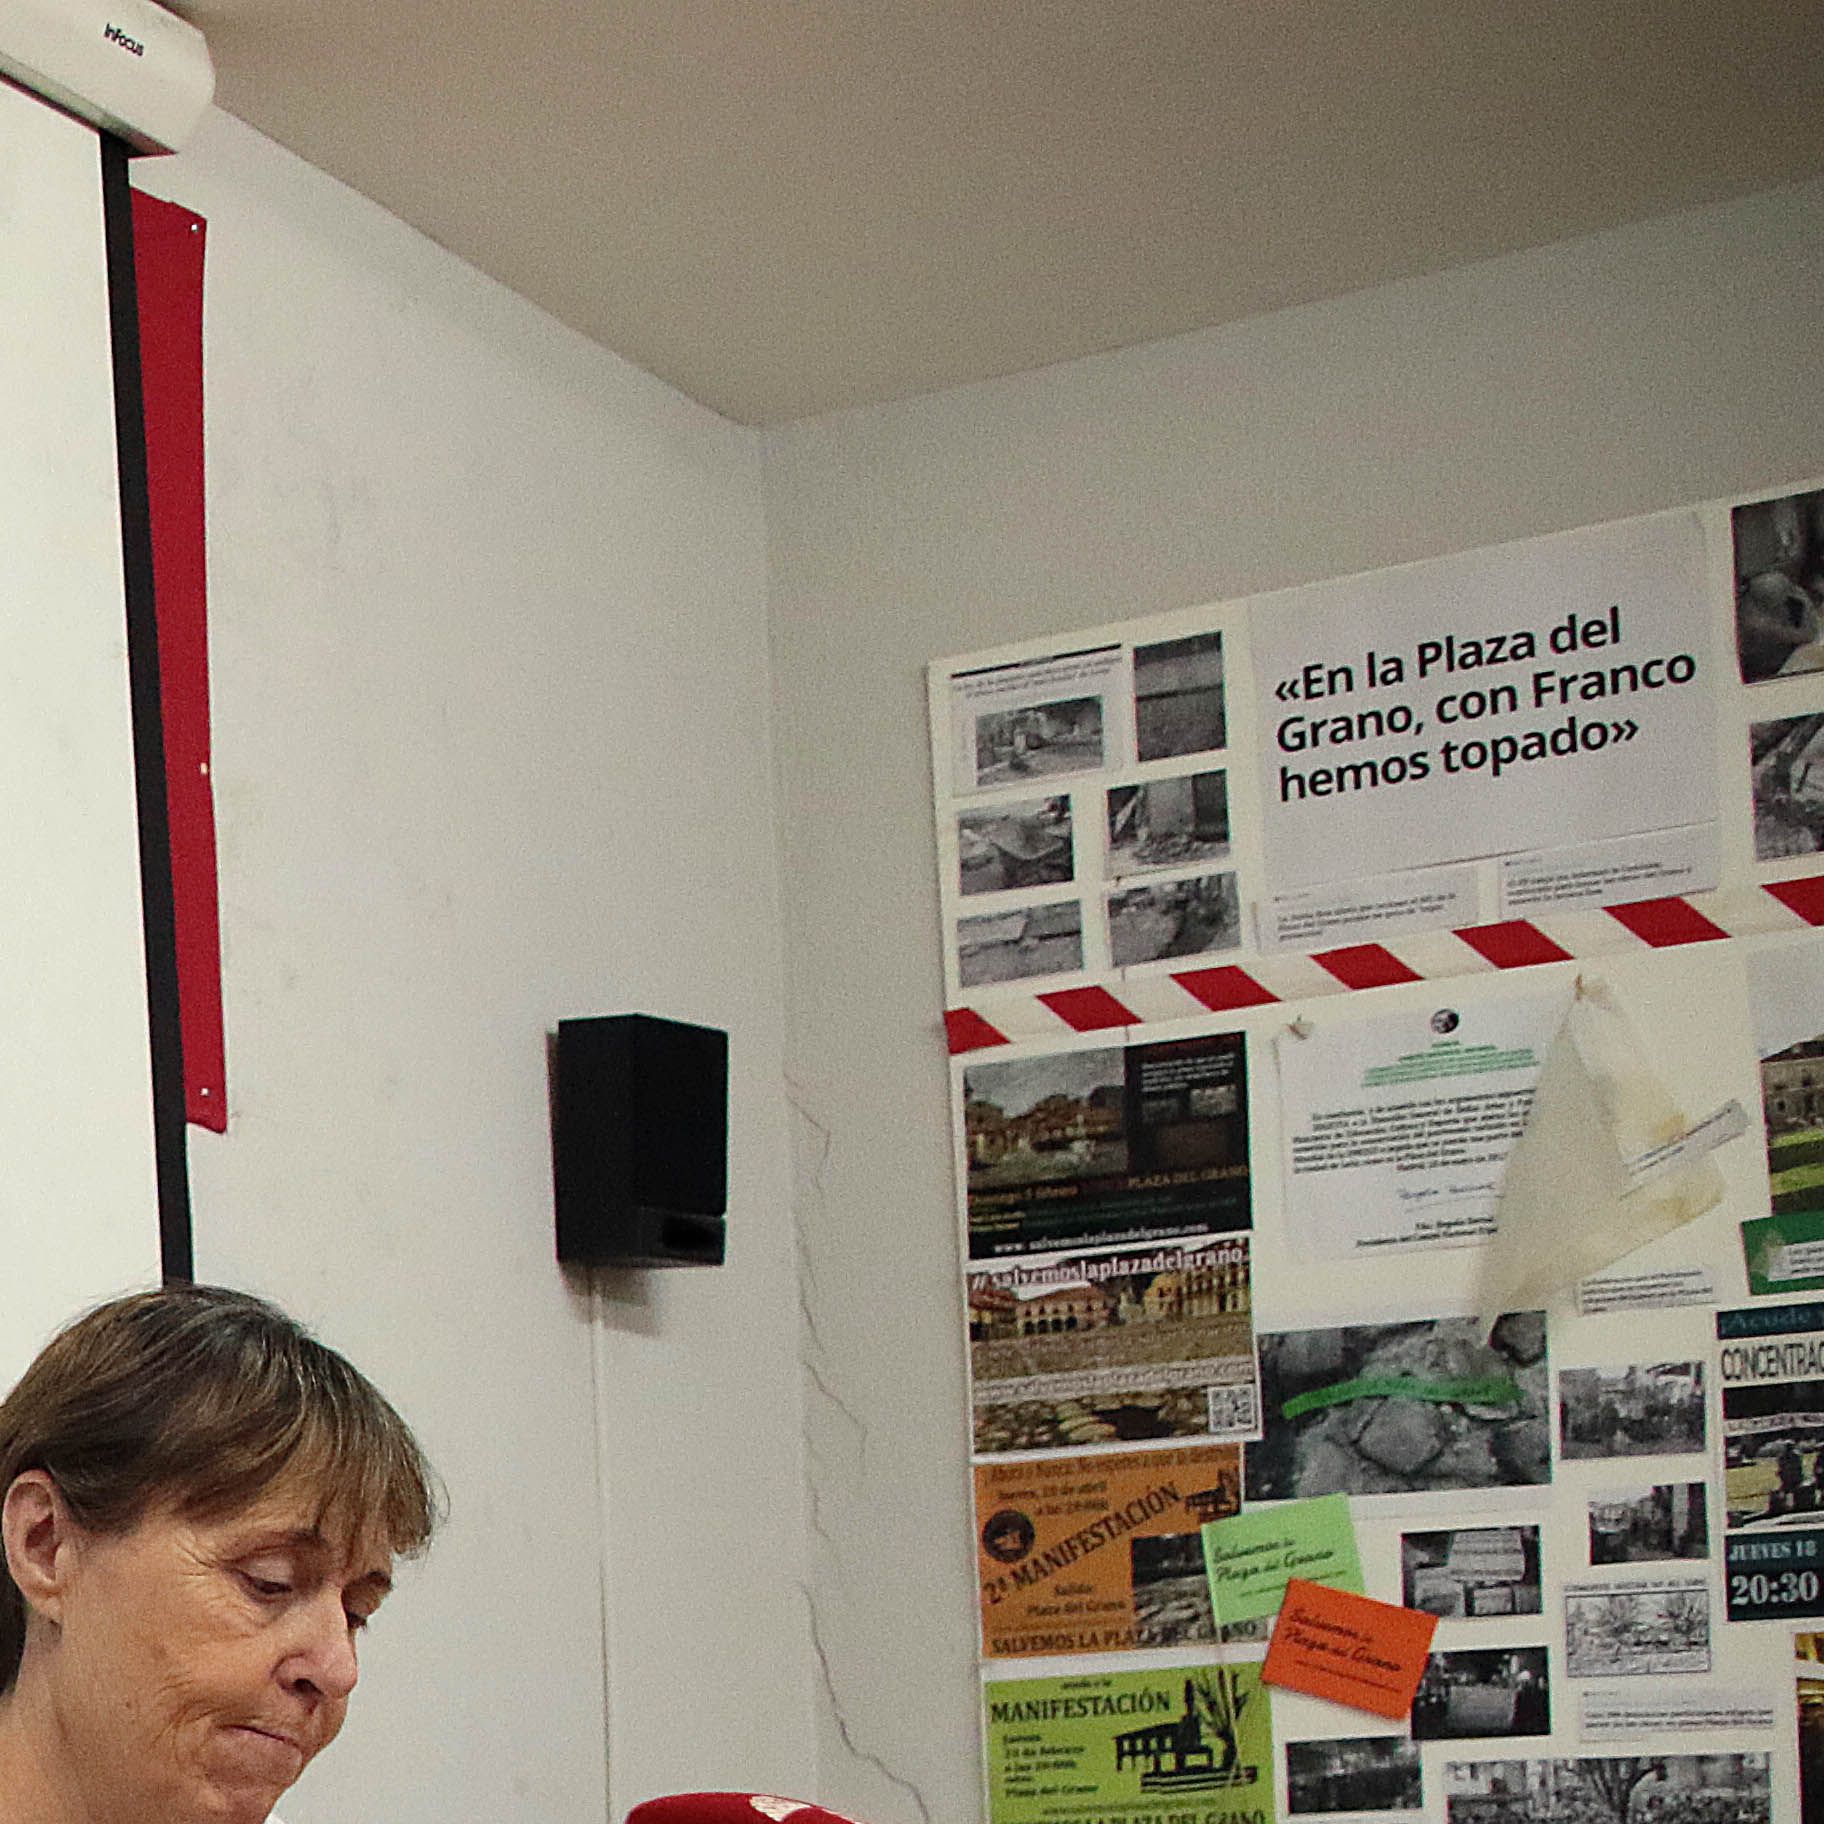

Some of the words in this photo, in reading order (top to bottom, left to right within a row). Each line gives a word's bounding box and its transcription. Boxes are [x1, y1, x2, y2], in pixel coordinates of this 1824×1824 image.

[1367, 649, 1404, 692] la
[1418, 629, 1537, 685] Plaza
[1550, 606, 1622, 657] del
[1277, 702, 1424, 755] Grano,
[1437, 688, 1519, 724] con
[1533, 652, 1697, 708] Franco
[1279, 752, 1431, 803] hemos
[1443, 713, 1640, 776] topado»
[1010, 1480, 1181, 1592] MANIFESTACIÓN
[1731, 1571, 1820, 1606] 20:30
[991, 1687, 1170, 1722] MANIFESTACIÓN
